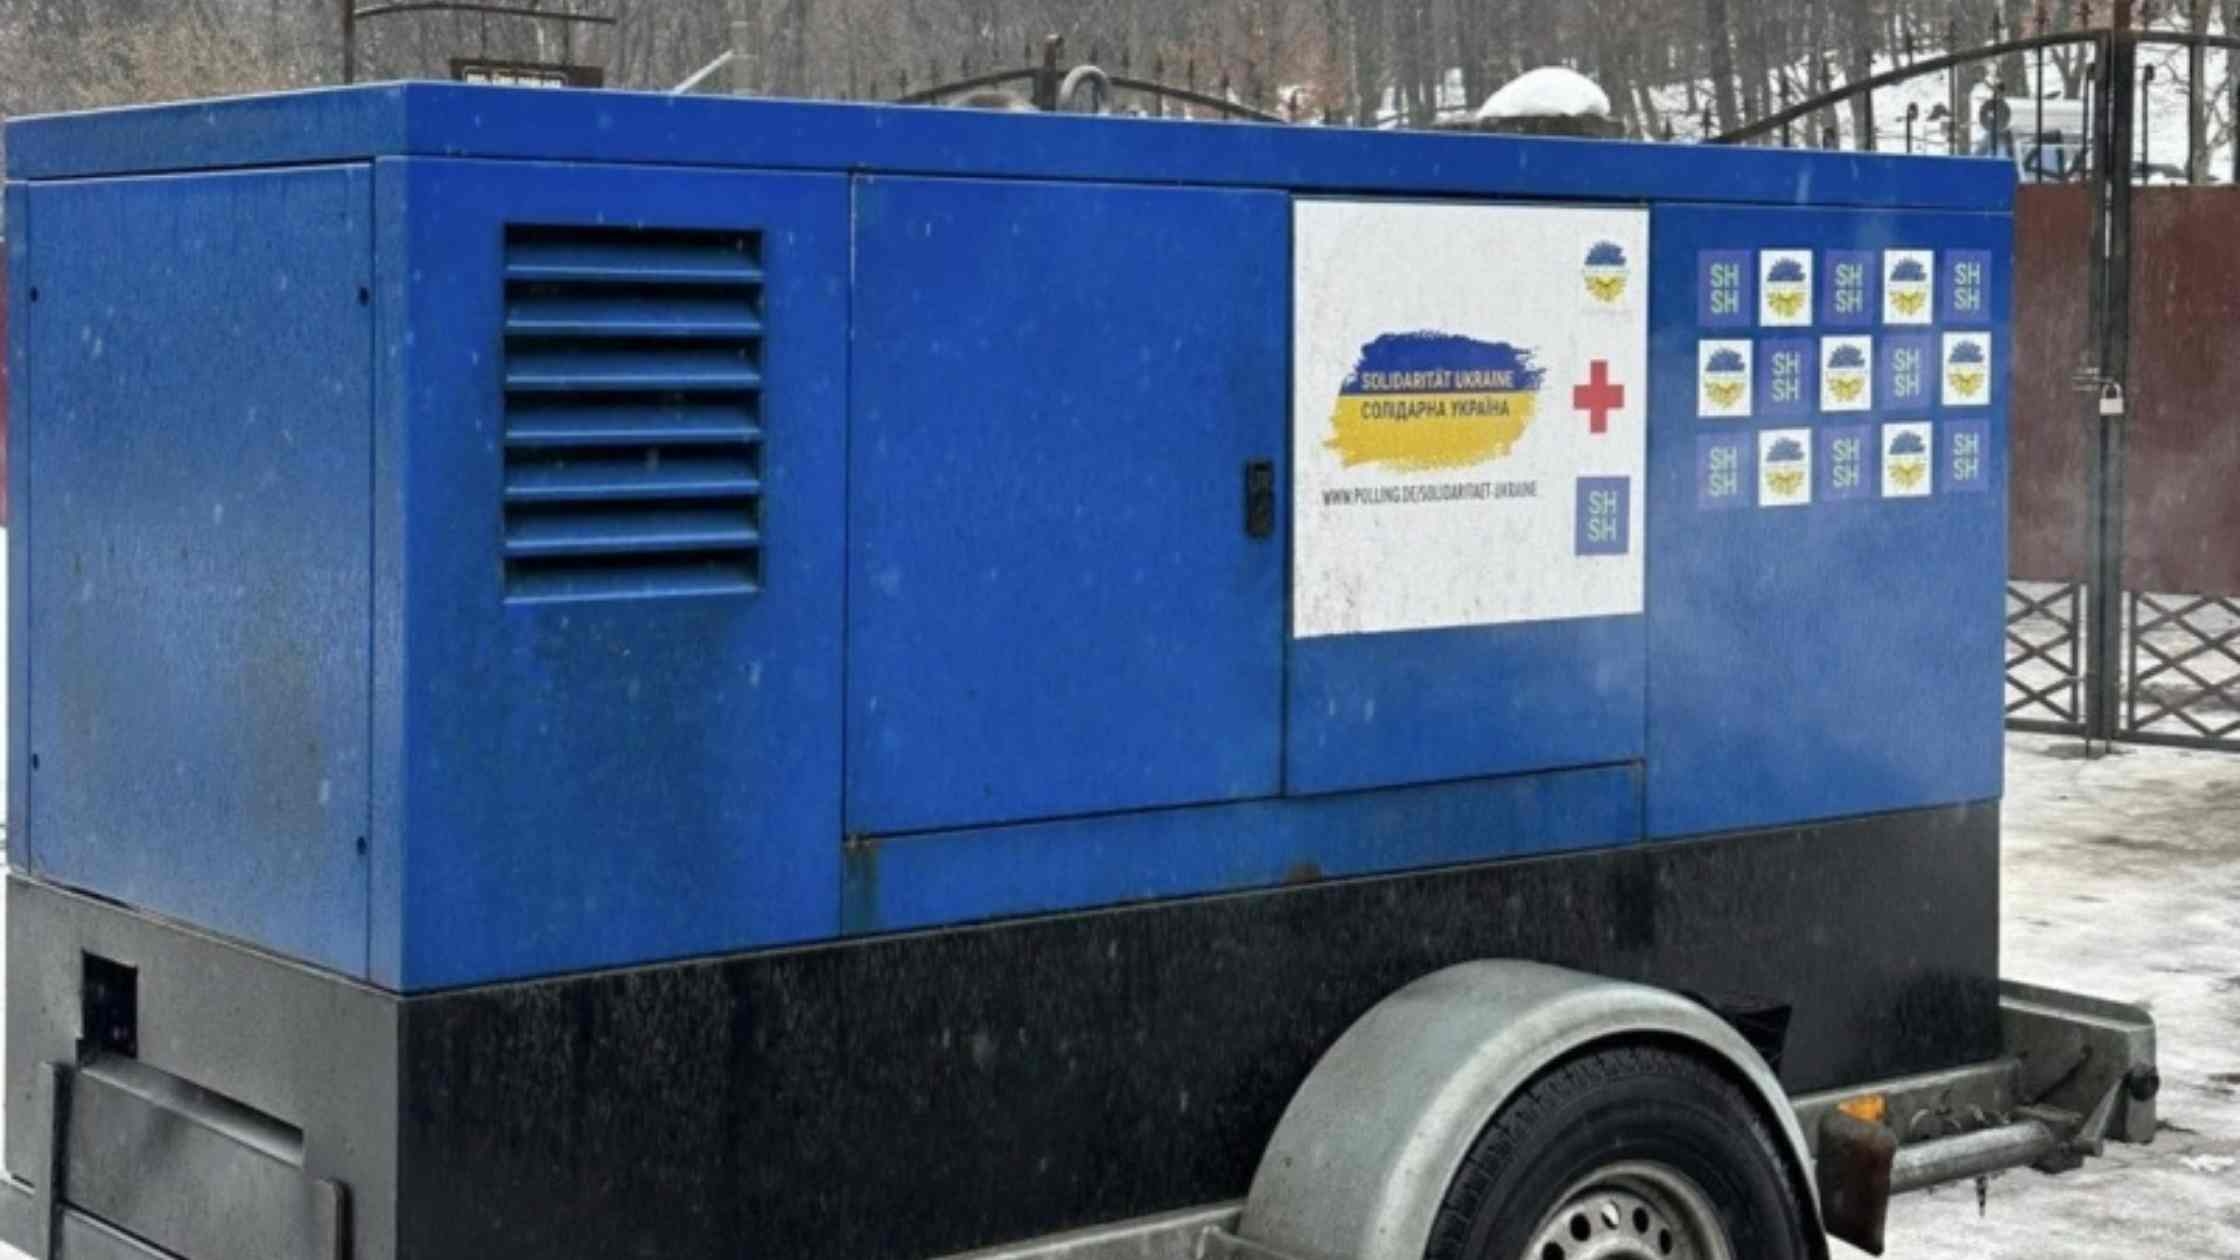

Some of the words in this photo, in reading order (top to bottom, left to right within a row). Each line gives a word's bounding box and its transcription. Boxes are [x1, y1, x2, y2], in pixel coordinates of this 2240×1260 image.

[1710, 264, 1739, 288] SH
[1835, 264, 1863, 288] SH
[1954, 263, 1981, 286] SH
[1710, 289, 1739, 314] SH
[1835, 289, 1863, 313] SH
[1954, 287, 1981, 310] SH
[1772, 352, 1800, 376] SH
[1893, 349, 1920, 372] SH
[1361, 370, 1452, 389] SOLIDARITÄT
[1457, 369, 1513, 389] UKRAINE
[1772, 377, 1800, 402] SH
[1893, 374, 1920, 397] SH
[1360, 400, 1446, 421] СОЛІДАРНА
[1451, 396, 1510, 418] УКРАЇНА
[1833, 438, 1859, 463] SH
[1953, 433, 1979, 456] SH
[1709, 447, 1737, 471] SH
[1953, 458, 1979, 481] SH
[1709, 472, 1737, 497] SH
[1833, 464, 1859, 488] SH
[1587, 490, 1618, 515] SH
[1587, 517, 1618, 542] SH
